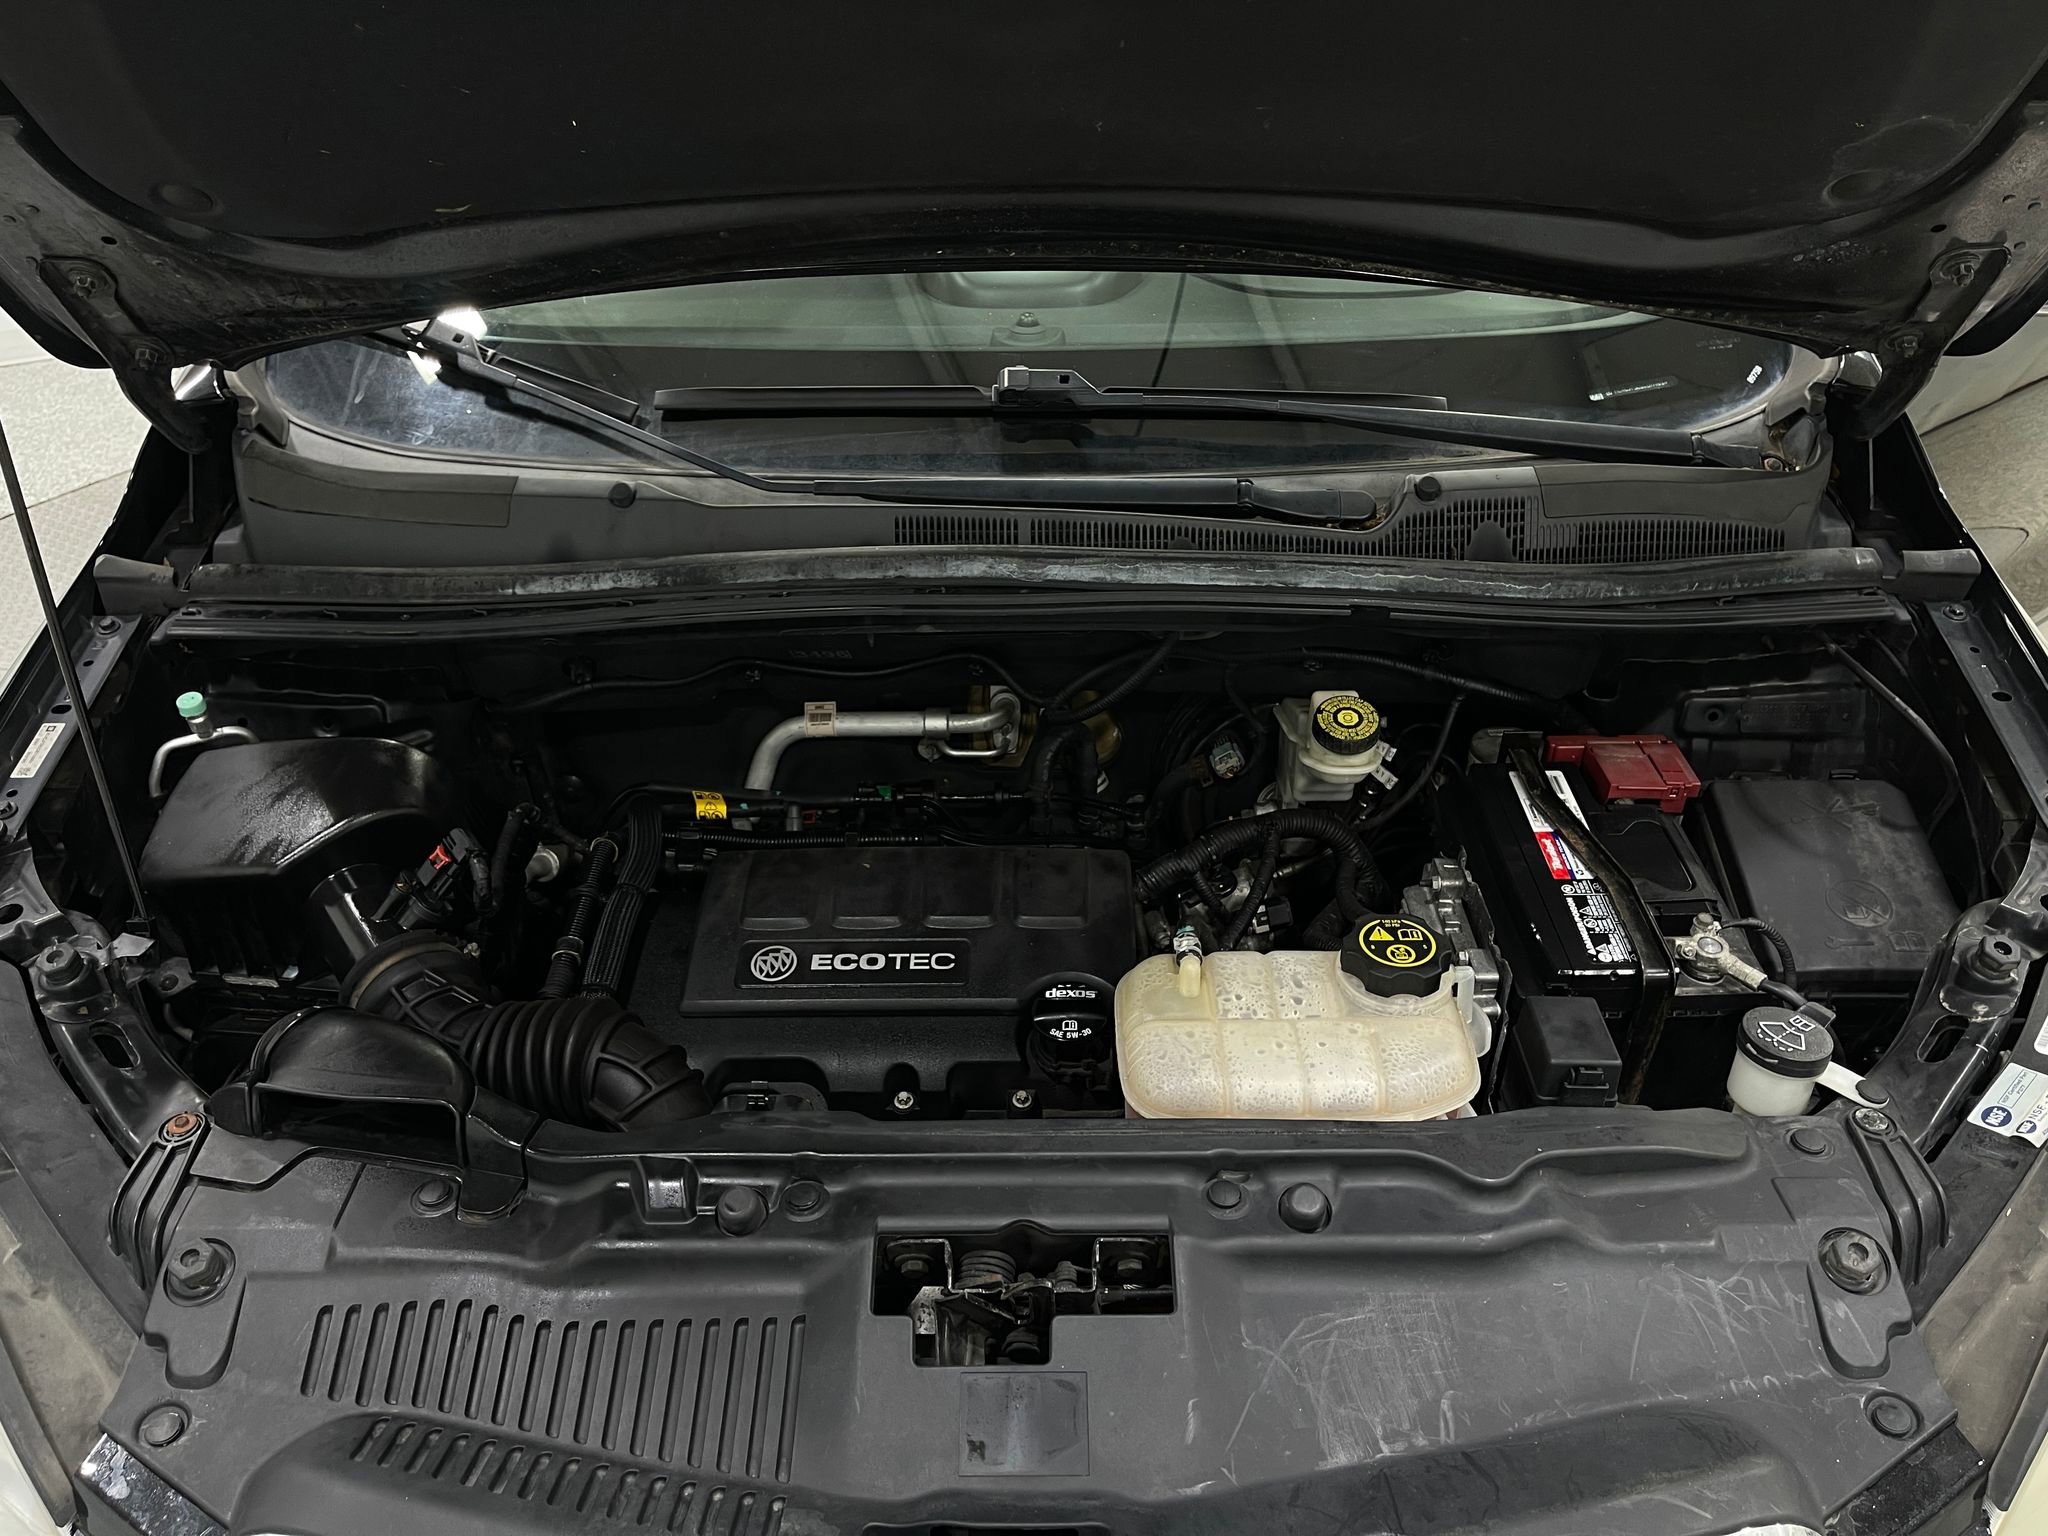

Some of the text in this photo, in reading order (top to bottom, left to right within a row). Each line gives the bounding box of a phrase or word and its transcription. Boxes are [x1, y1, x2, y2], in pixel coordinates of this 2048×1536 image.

[810, 953, 956, 971] ECOTEC
[1045, 988, 1096, 998] dexos
[1049, 1028, 1092, 1039] SAE 5W-30
[1985, 1107, 2007, 1126] NSF
